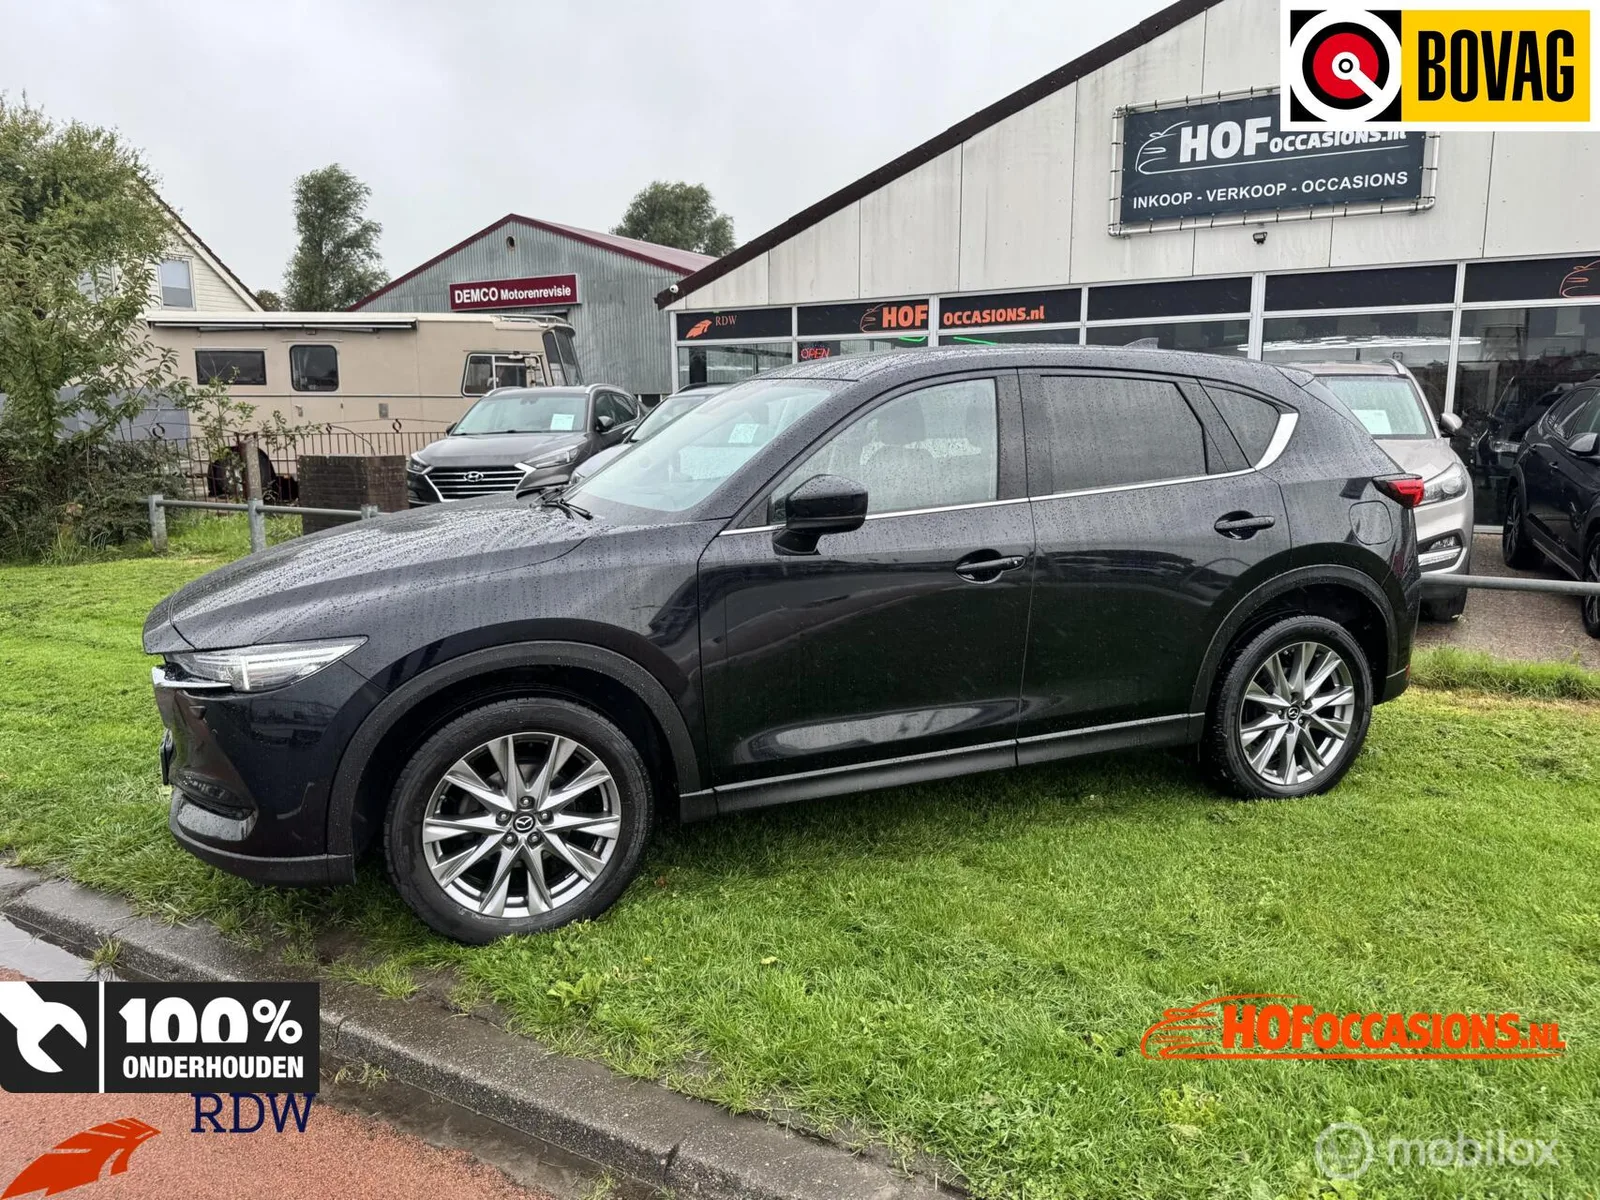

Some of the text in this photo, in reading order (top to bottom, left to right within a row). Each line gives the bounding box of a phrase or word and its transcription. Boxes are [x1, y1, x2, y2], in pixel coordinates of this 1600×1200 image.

[1132, 191, 1193, 210] INKOOP
[1206, 182, 1287, 202] VERKOOP
[1301, 171, 1408, 193] OCCASIONS
[454, 284, 572, 304] DEMCO Motorenrevisie
[715, 315, 738, 327] RDW
[882, 304, 1046, 328] HOF OCCASIONS.nl
[800, 347, 831, 359] OPEN
